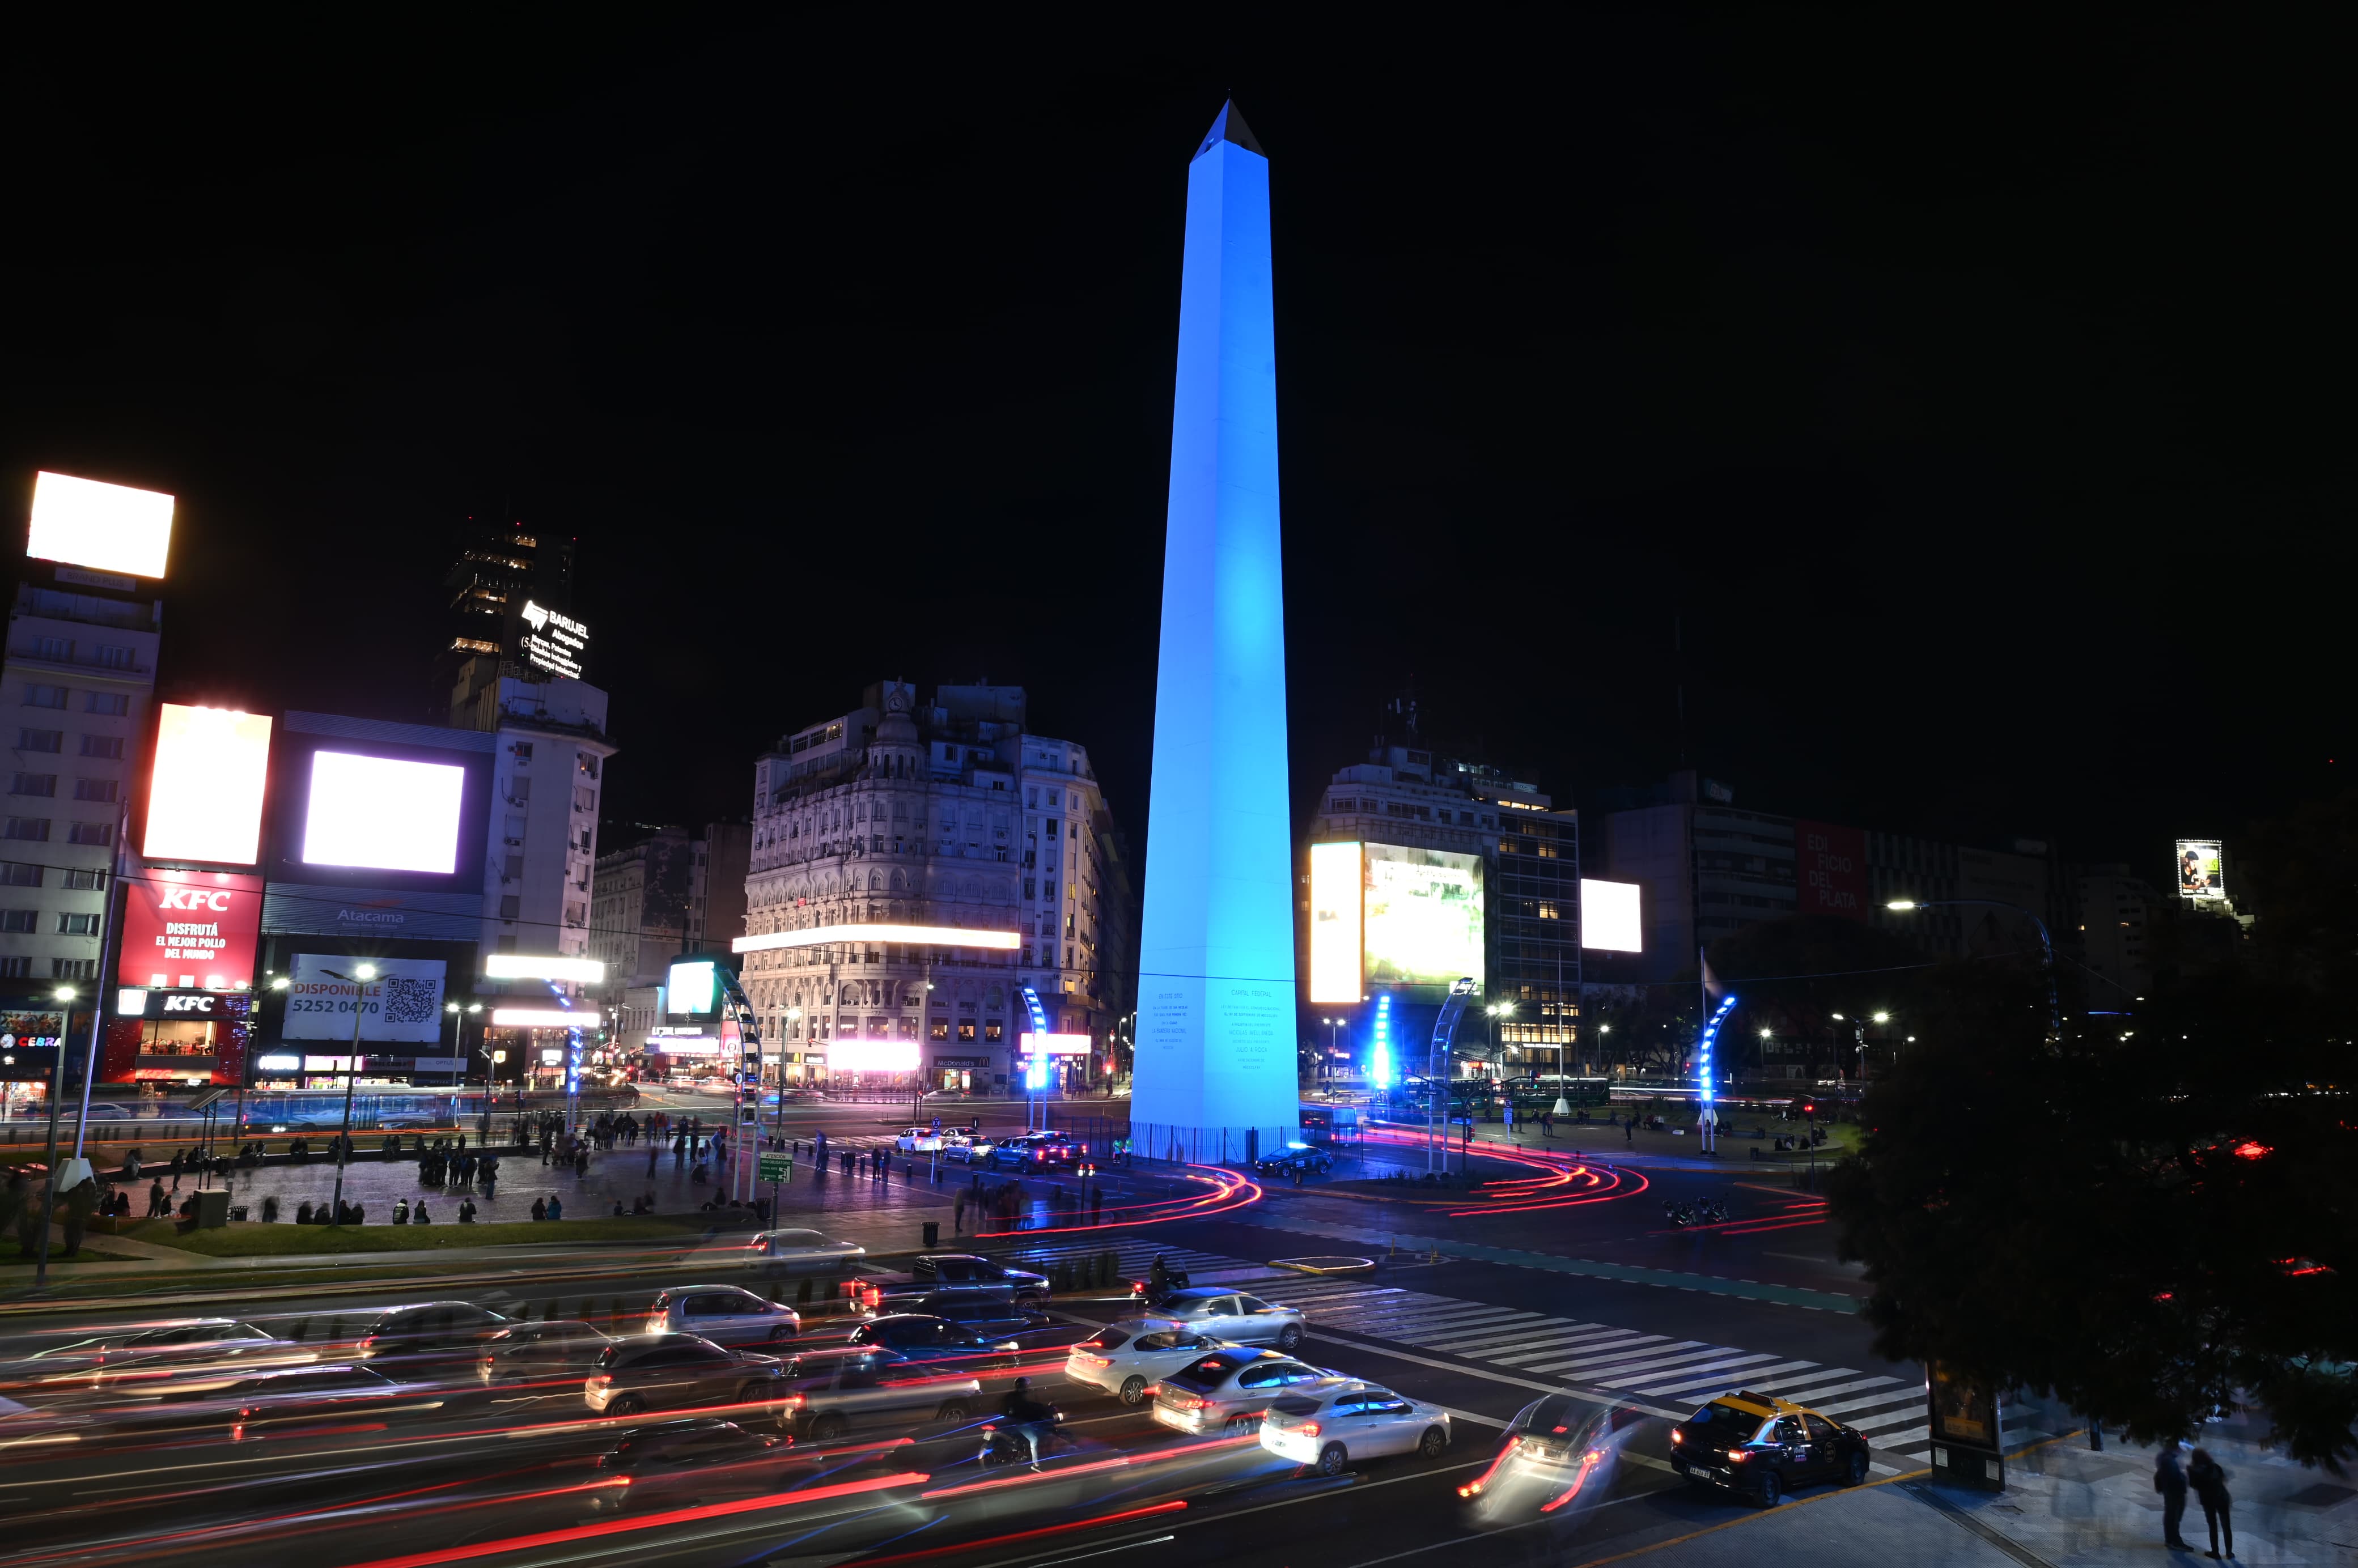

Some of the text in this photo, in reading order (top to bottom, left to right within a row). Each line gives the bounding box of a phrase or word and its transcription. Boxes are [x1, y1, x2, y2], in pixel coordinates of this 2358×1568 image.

[68, 572, 124, 587] BRAND PLUS
[549, 610, 589, 639] BARUJEL
[552, 629, 584, 650] Abogados
[530, 653, 555, 671] Propiedad
[1807, 834, 1828, 853] EDI
[1818, 852, 1852, 873] FICIO
[1809, 870, 1833, 889] DEL
[159, 888, 231, 911] KFC
[1818, 889, 1857, 910] PLATA
[337, 910, 404, 923] Atacama
[166, 922, 218, 936] DISFRUTÁ
[155, 936, 226, 948] EL MEJOR POLLO
[164, 948, 215, 959] DEL MUNDO
[164, 996, 215, 1012] KFC
[292, 999, 379, 1014] 5252 0470
[18, 1036, 61, 1047] CEBRA
[139, 1069, 174, 1080] KFC
